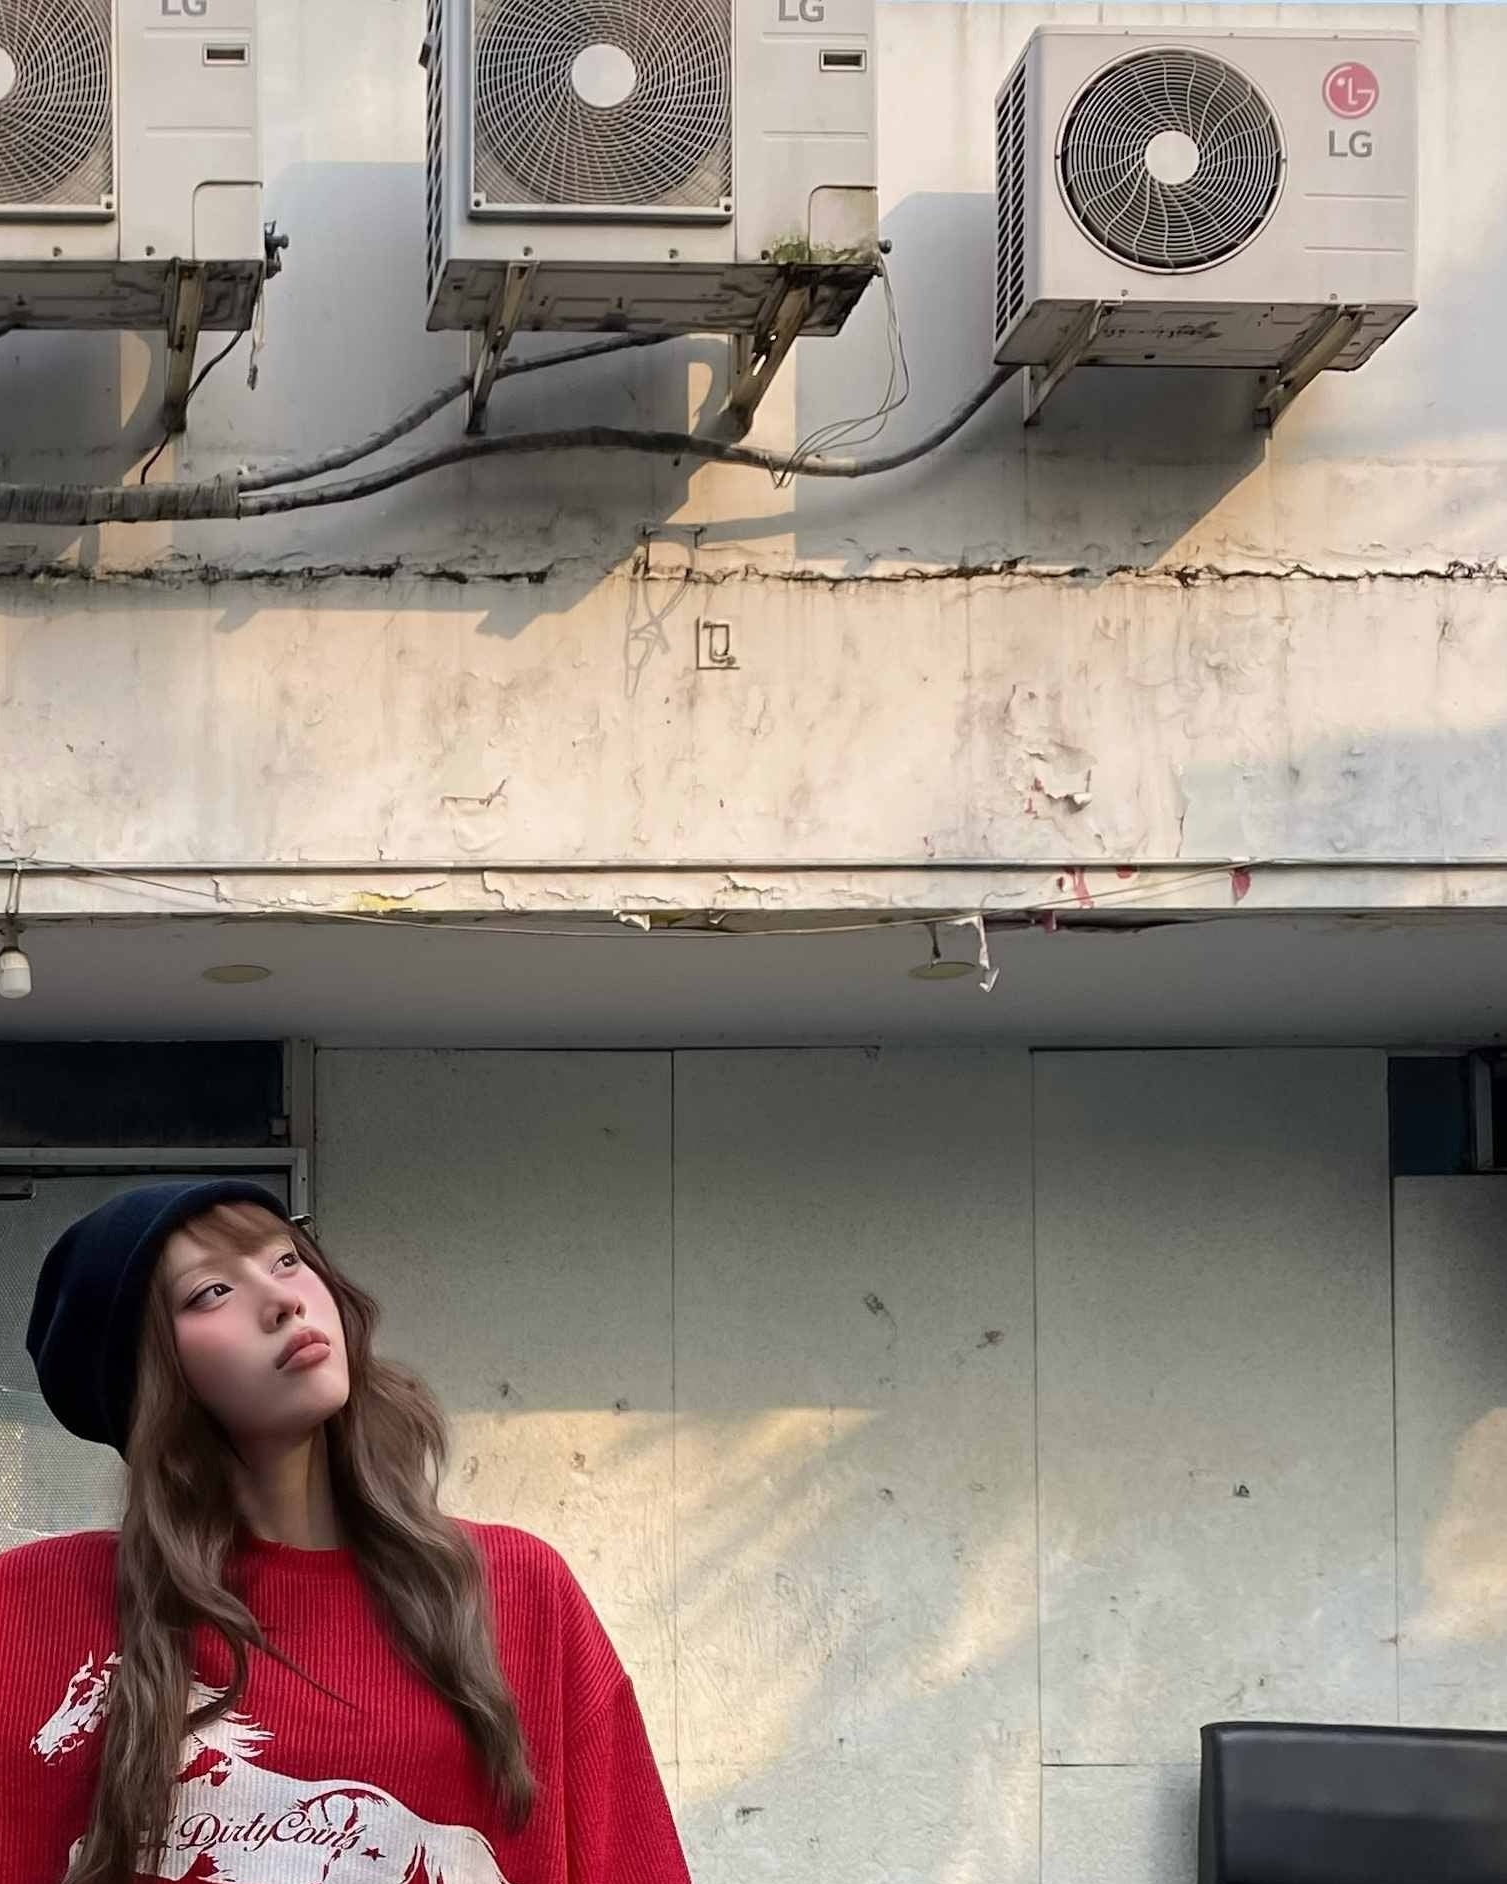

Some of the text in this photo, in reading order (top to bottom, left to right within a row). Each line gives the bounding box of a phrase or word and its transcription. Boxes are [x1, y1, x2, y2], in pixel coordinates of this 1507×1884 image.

[162, 0, 207, 17] LG
[779, 0, 824, 22] LG
[1328, 130, 1373, 158] LG
